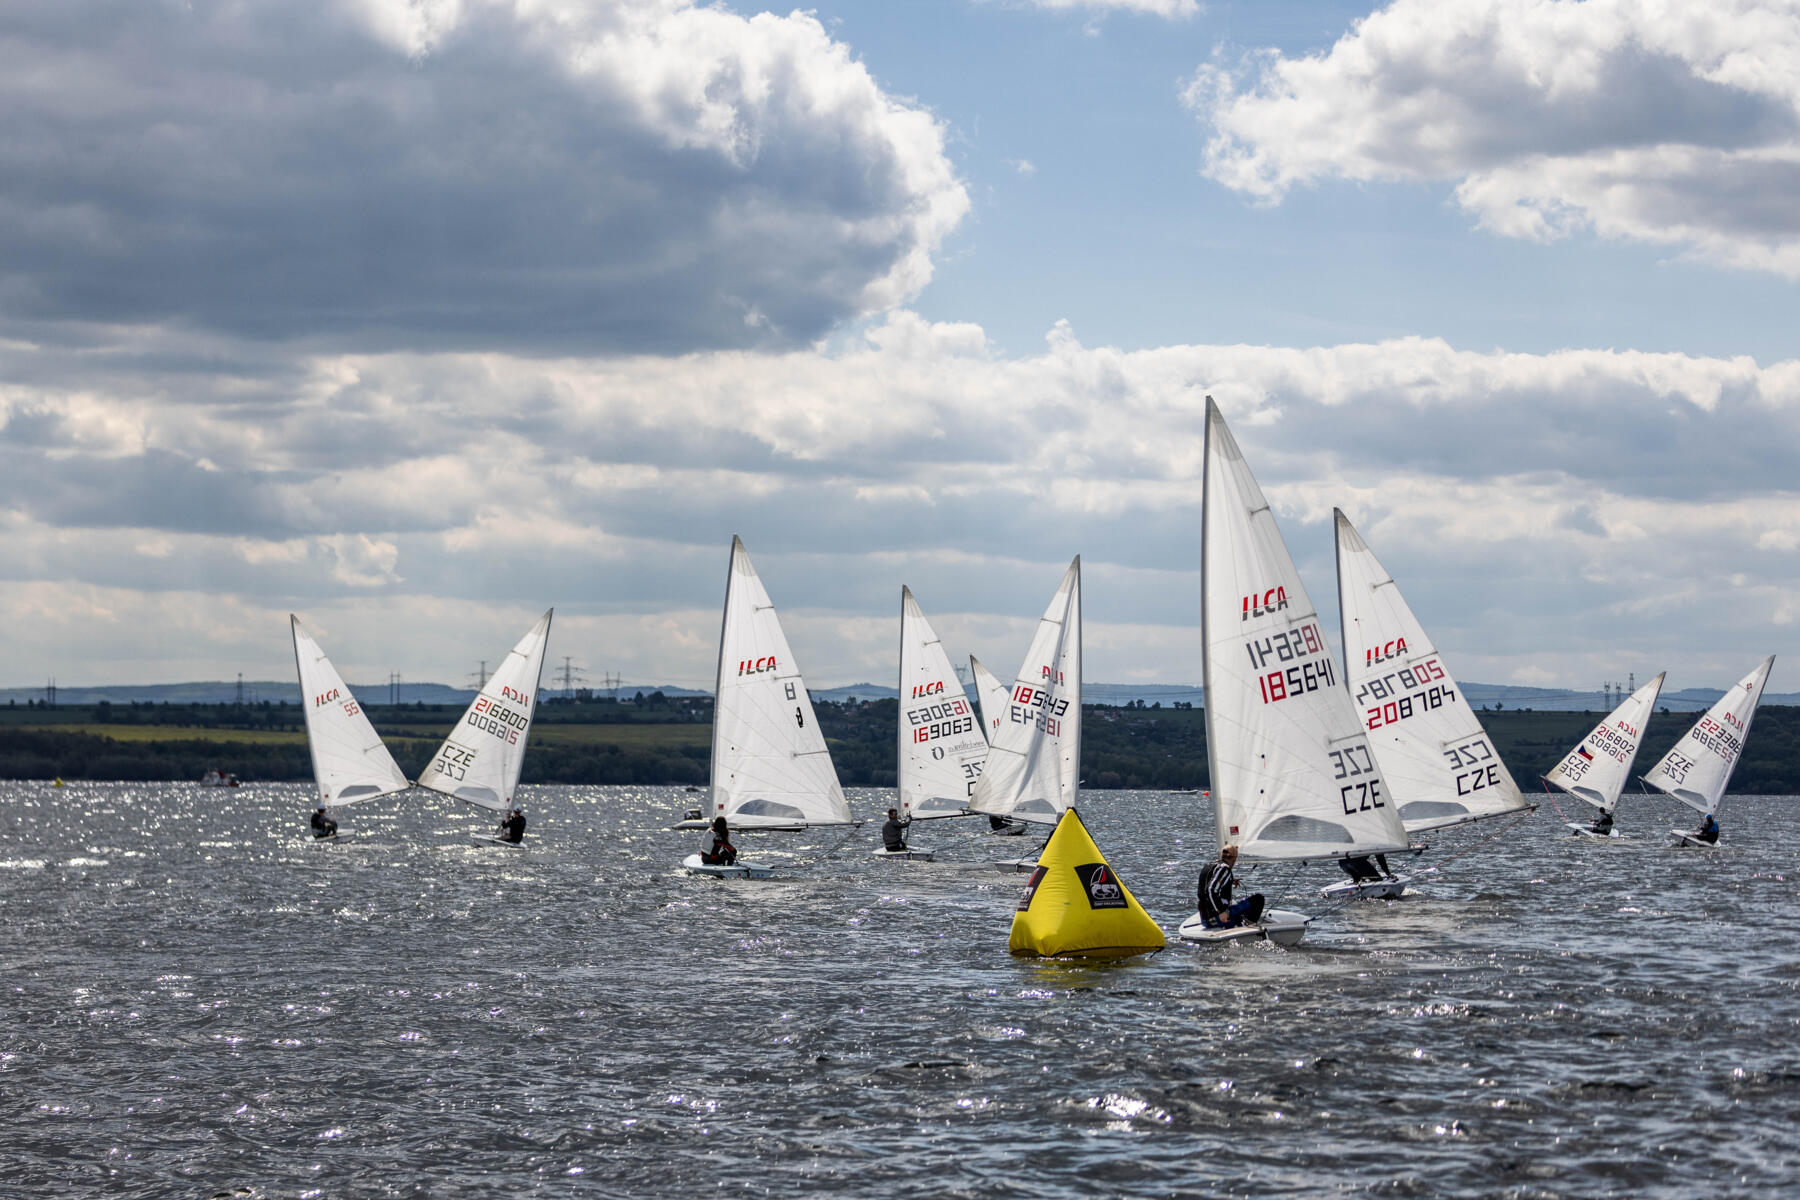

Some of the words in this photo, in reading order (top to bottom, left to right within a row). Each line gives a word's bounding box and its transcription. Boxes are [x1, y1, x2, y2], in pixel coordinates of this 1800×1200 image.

[1242, 586, 1288, 621] ILCA
[738, 655, 777, 677] ILCA
[1366, 637, 1408, 668] ILCA
[912, 681, 944, 699] ILCA
[1259, 658, 1335, 704] 185641
[316, 688, 340, 707] ILCA
[1367, 684, 1455, 731] 208784
[475, 697, 528, 731] 216800
[913, 717, 972, 744] 169063
[1597, 725, 1635, 755] 216802
[442, 745, 475, 767] CZE
[1567, 755, 1590, 774] CZE
[1667, 752, 1694, 773] CZE
[1456, 764, 1500, 796] CZE
[1341, 779, 1385, 815] CZE
